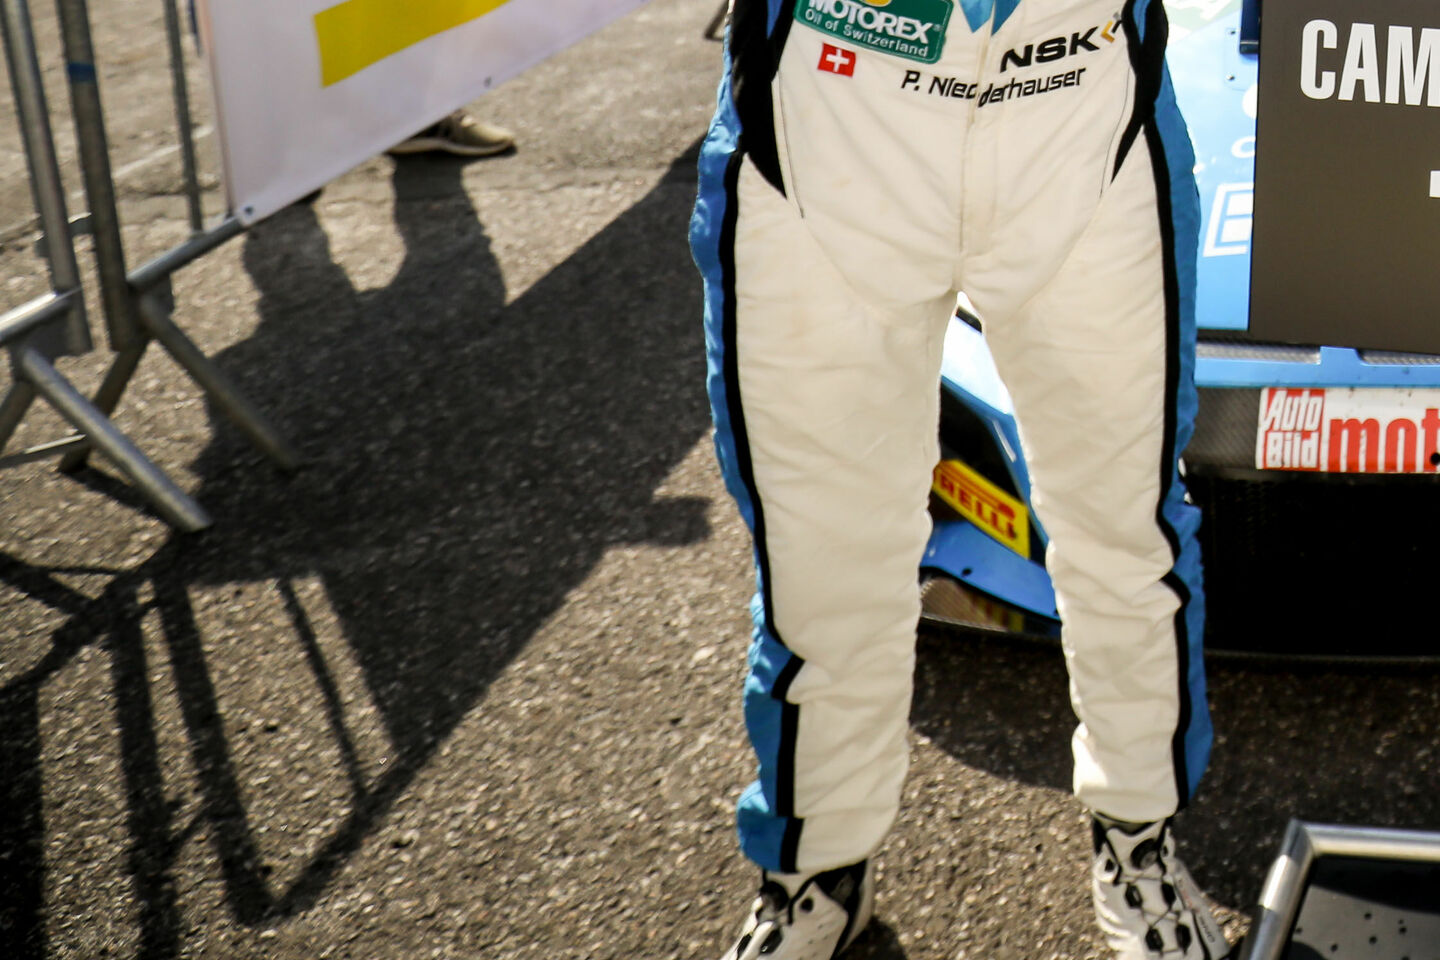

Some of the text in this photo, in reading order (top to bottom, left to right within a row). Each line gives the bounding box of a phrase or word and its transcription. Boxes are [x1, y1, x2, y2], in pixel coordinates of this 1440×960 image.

[805, 8, 929, 58] Oil of Switzerland
[999, 26, 1100, 74] NSK
[901, 70, 921, 91] P.
[1262, 388, 1324, 430] Auto
[1263, 429, 1321, 470] Bild
[934, 464, 1017, 541] RELLI
